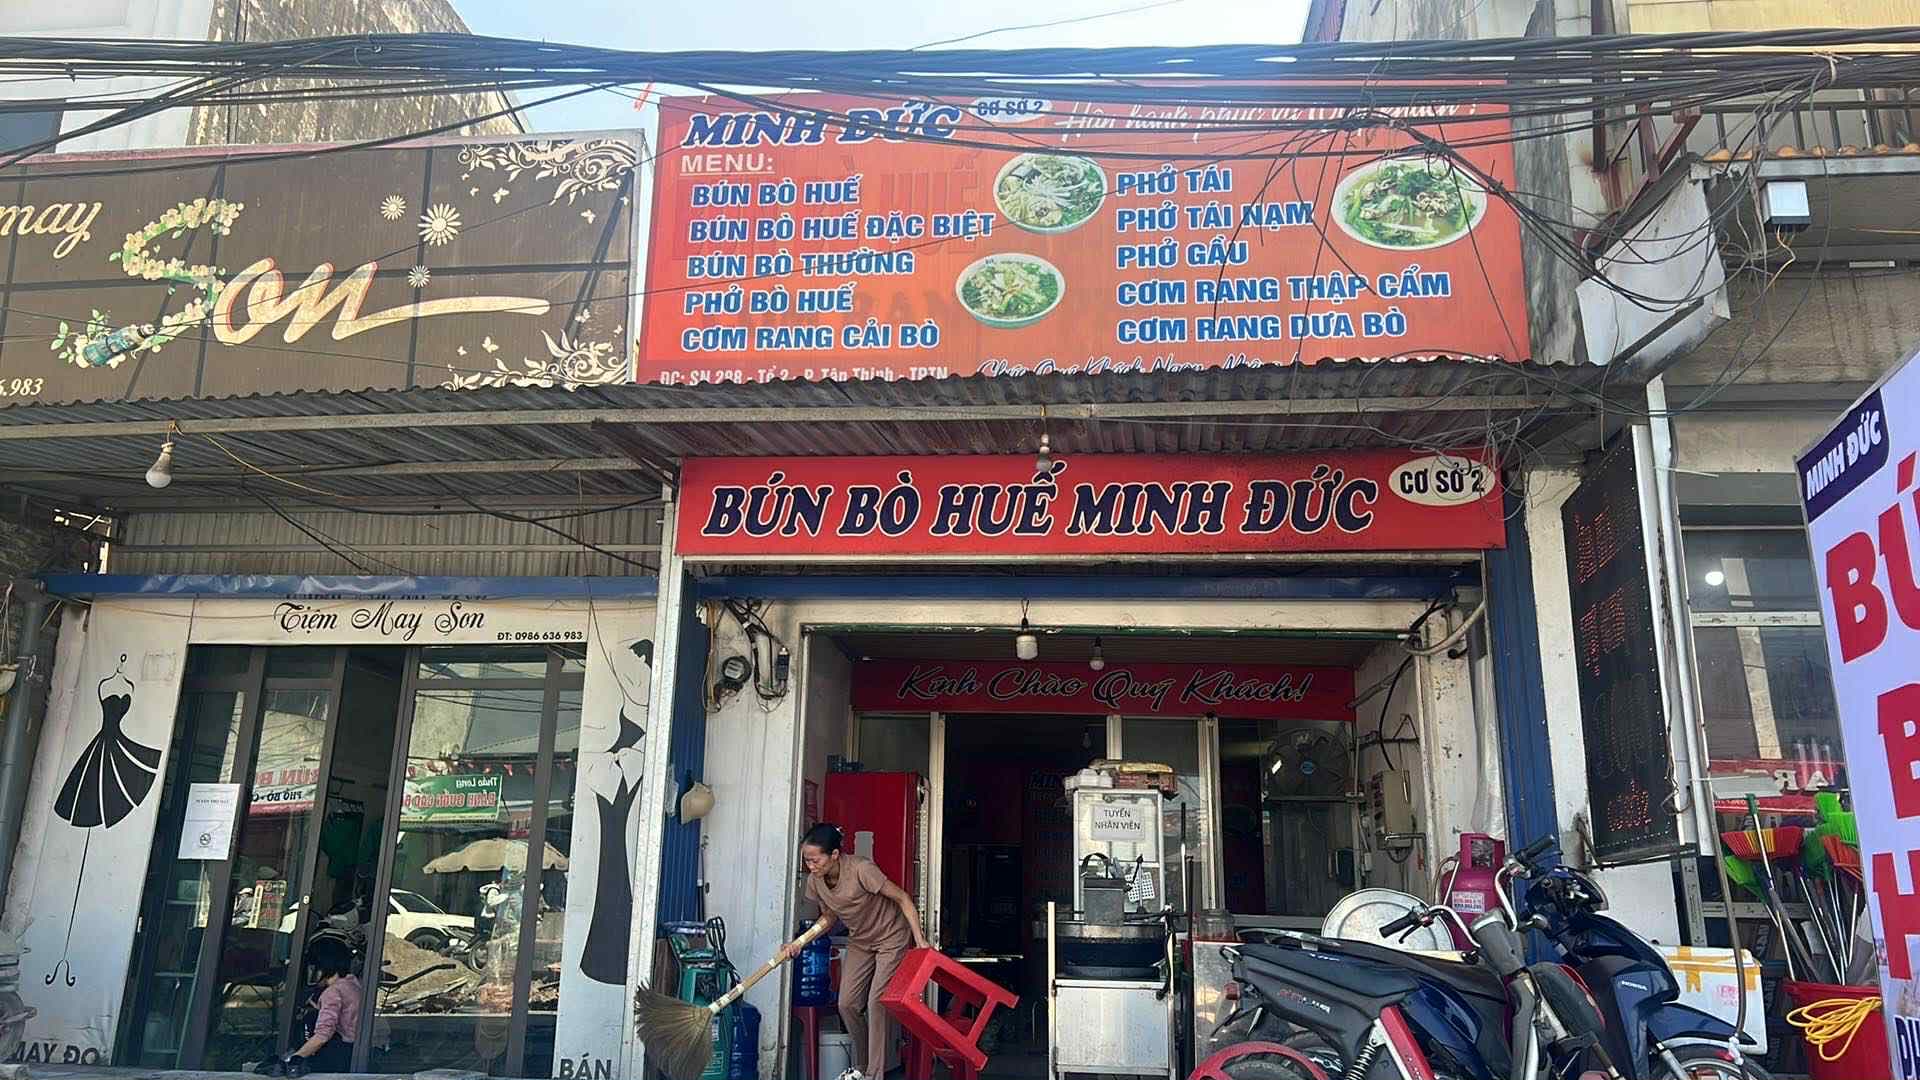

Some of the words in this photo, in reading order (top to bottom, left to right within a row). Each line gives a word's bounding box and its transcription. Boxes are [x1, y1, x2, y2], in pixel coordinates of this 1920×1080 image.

[681, 112, 826, 148] MINH
[835, 98, 962, 144] ĐỨC
[681, 153, 775, 173] MENU:
[1116, 164, 1178, 196] PHỞ
[1184, 165, 1233, 192] TÁI
[691, 180, 751, 207] BÚN
[757, 177, 798, 206] BÒ
[803, 173, 863, 205] HUẾ
[688, 215, 748, 242] BÚN
[755, 211, 796, 242] BÒ
[801, 209, 862, 240] HUẾ
[865, 210, 924, 243] ĐẶC
[931, 209, 997, 241] BIỆT
[1117, 200, 1178, 233] PHỞ
[1184, 200, 1234, 230] TÁI
[1241, 202, 1316, 231] NẠM
[685, 250, 746, 278] BÚN
[754, 248, 794, 277] BÒ
[799, 246, 915, 277] THƯỜNG
[1116, 236, 1178, 269] PHỞ
[1186, 233, 1249, 266] GẦU
[683, 284, 745, 315] PHỞ
[749, 286, 790, 314] BÒ
[795, 282, 855, 312] HUẾ
[1117, 279, 1186, 306] CƠM
[1195, 277, 1280, 303] RANG
[1288, 271, 1369, 304] THẬP
[1376, 264, 1451, 298] CẨM
[682, 325, 748, 351] CƠM
[755, 325, 834, 349] RANG
[841, 317, 893, 348] CẢI
[899, 318, 941, 347] BÒ
[1117, 316, 1187, 343] CƠM
[1196, 314, 1281, 341] RANG
[1289, 311, 1354, 338] DƯA
[1362, 307, 1407, 337] BÒ
[1806, 441, 1846, 501] MINH
[1846, 409, 1882, 468] ĐỨC
[1400, 468, 1430, 494] CƠ
[1435, 462, 1465, 494] SỞ
[1471, 469, 1485, 493] 2
[701, 471, 834, 537] BÚN
[836, 471, 922, 537] BÒ
[929, 461, 1068, 537] HUẾ
[1065, 481, 1236, 537] MINH
[1239, 464, 1379, 534] ĐỨC
[273, 602, 339, 634] Tiệm
[349, 599, 424, 641] May
[433, 600, 486, 636] Son
[496, 632, 513, 641] ĐT:
[514, 630, 541, 642] 0986
[544, 630, 562, 641] 636
[563, 630, 584, 640] 983
[987, 667, 1088, 701] Chào
[1179, 668, 1314, 704] Khách!
[1094, 820, 1119, 830] NHÂN
[559, 1052, 612, 1080] BÁN
